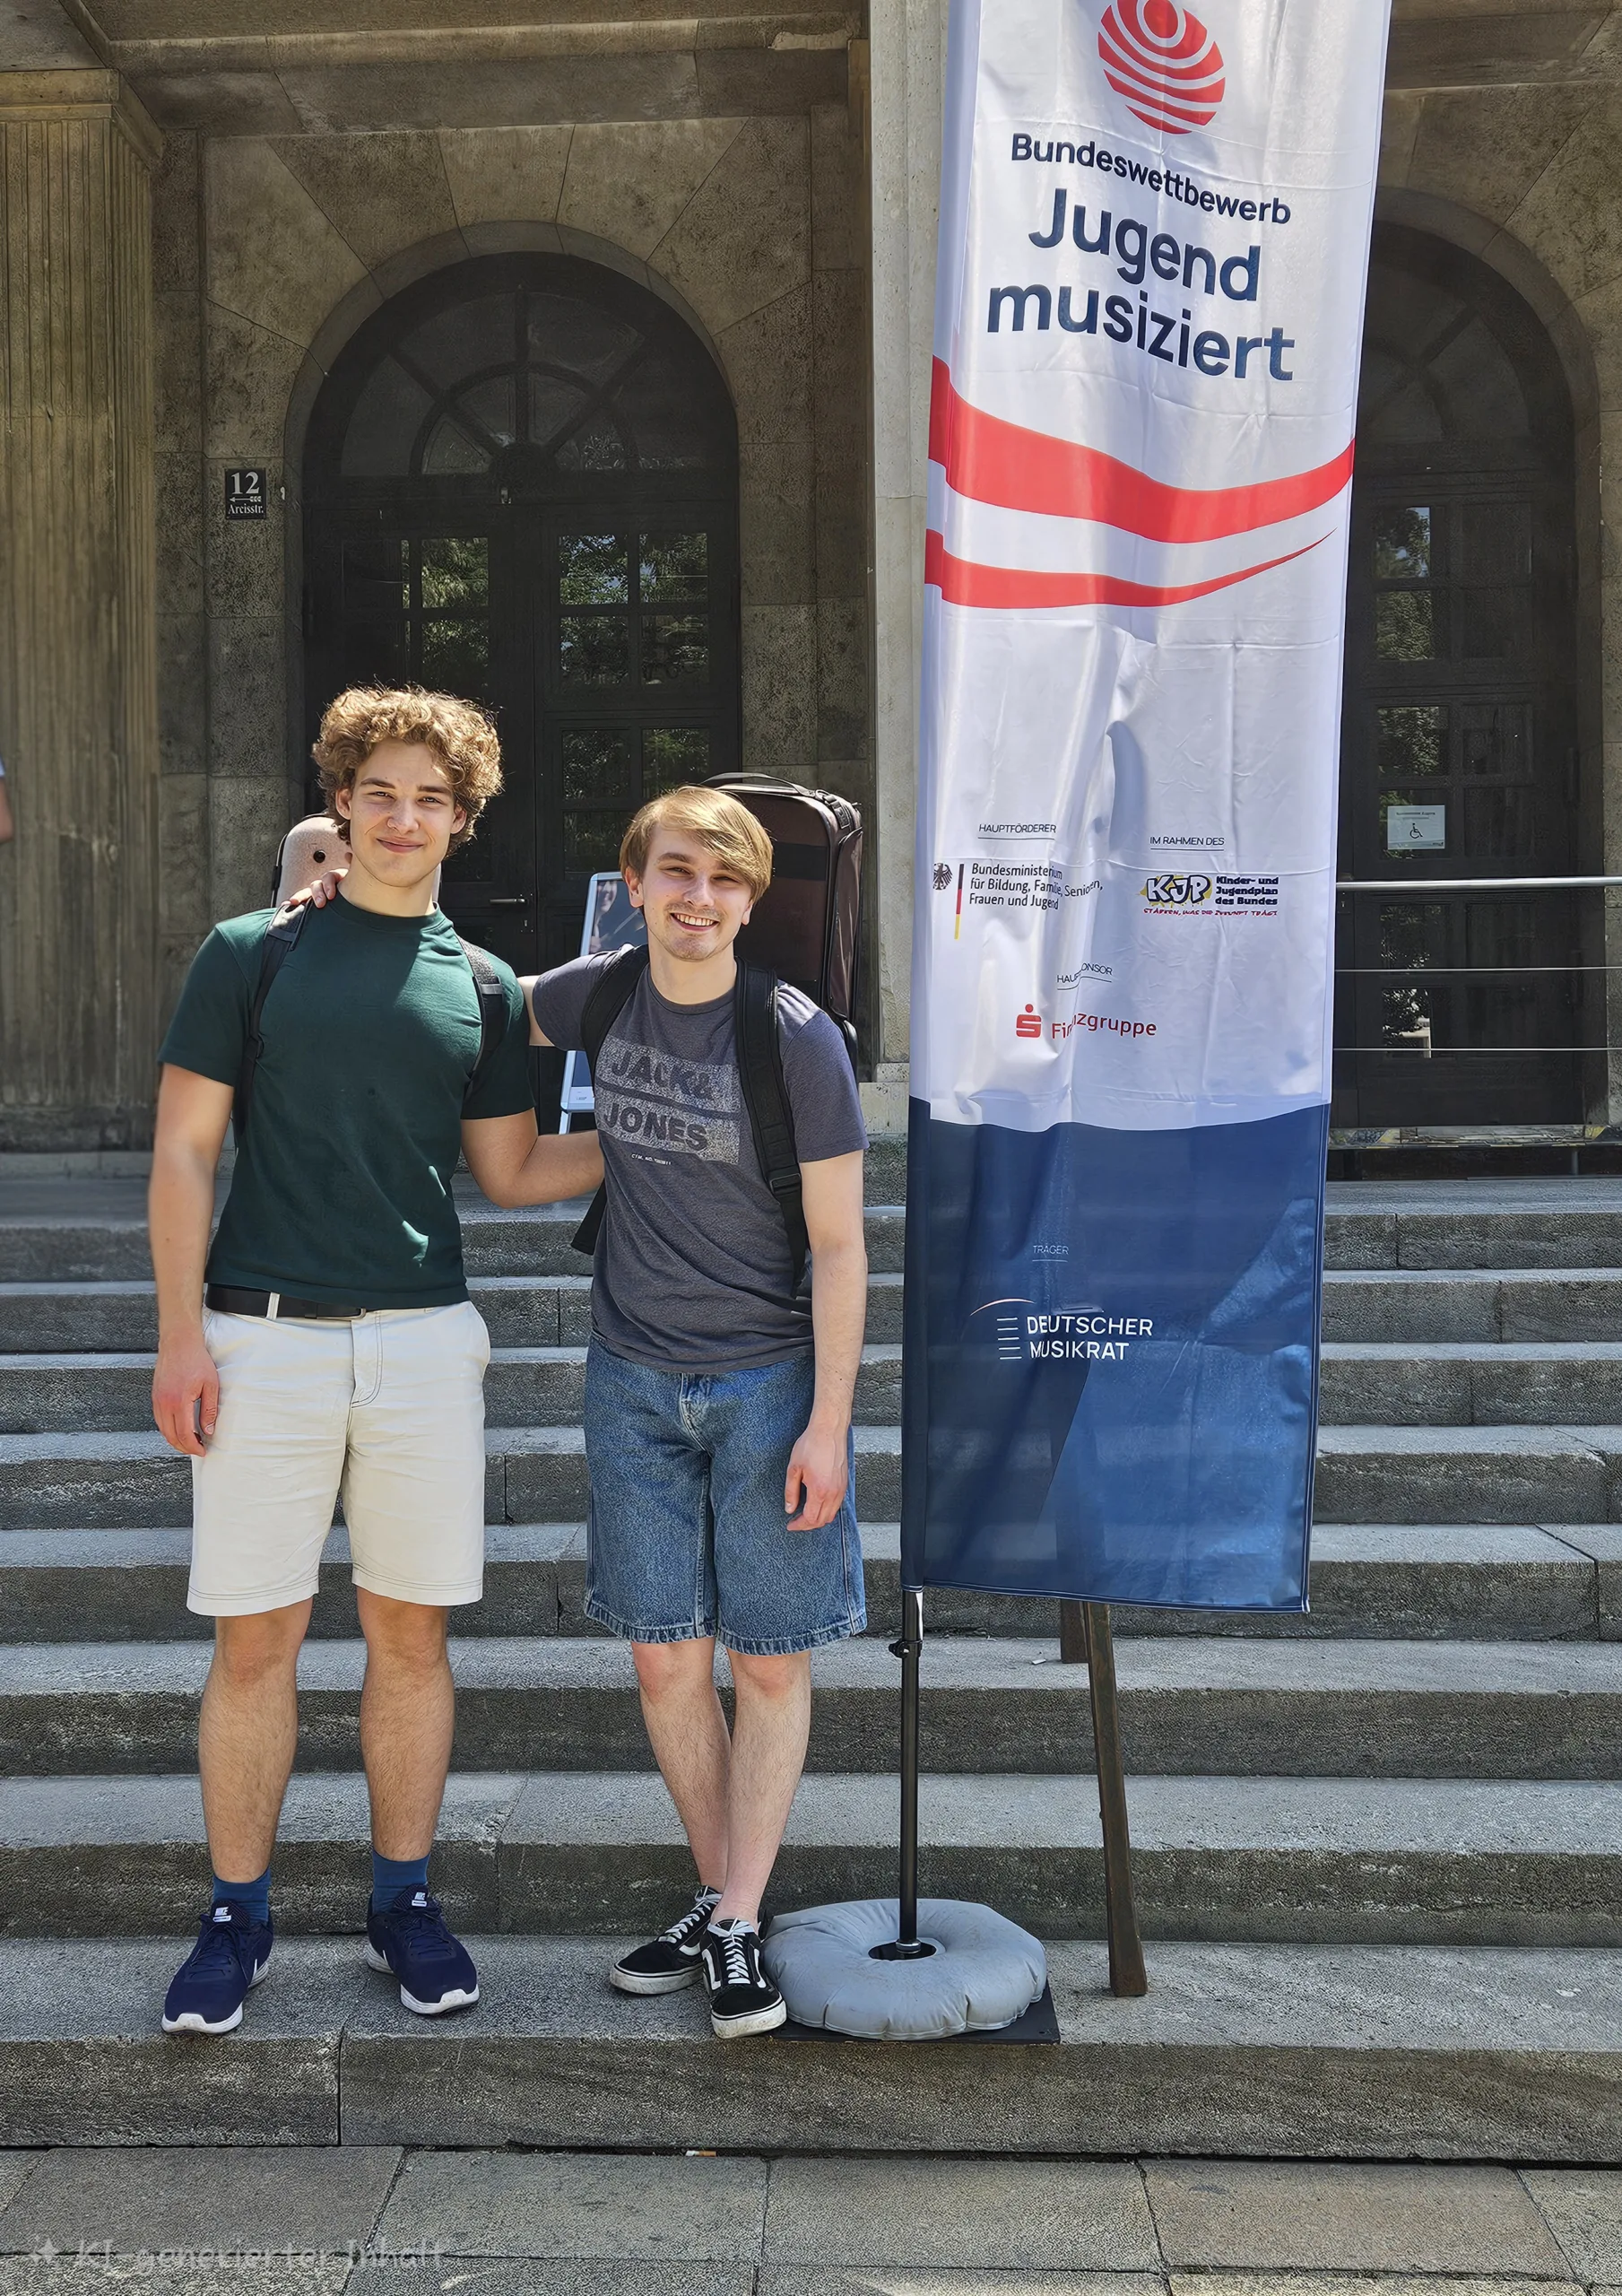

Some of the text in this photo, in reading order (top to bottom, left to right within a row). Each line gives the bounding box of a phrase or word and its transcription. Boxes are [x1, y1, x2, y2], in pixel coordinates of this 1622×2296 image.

[1011, 133, 1291, 224] Bundeswettbewerb
[1028, 187, 1261, 301] Jugend
[987, 282, 1295, 381] musiziert
[231, 472, 259, 494] 12
[229, 503, 264, 514] Arcisstr.
[979, 823, 1056, 833] HAUPTFÖRDERER
[1163, 837, 1203, 846] RAHMEN
[1206, 838, 1225, 846] DES
[970, 878, 984, 890] für
[987, 879, 1031, 893] Bildung,
[1216, 876, 1279, 885] Kinder- und
[1146, 874, 1211, 904] KJP
[1216, 886, 1278, 897] Jugendplan
[969, 893, 1004, 905] Frauen
[1008, 895, 1028, 906] und
[1215, 897, 1234, 905] des
[603, 1102, 708, 1151] JONES
[1033, 1245, 1069, 1255] TRÄGER
[1027, 1315, 1153, 1335] DEUTSCHER
[1030, 1341, 1130, 1360] MUSIKRAT
